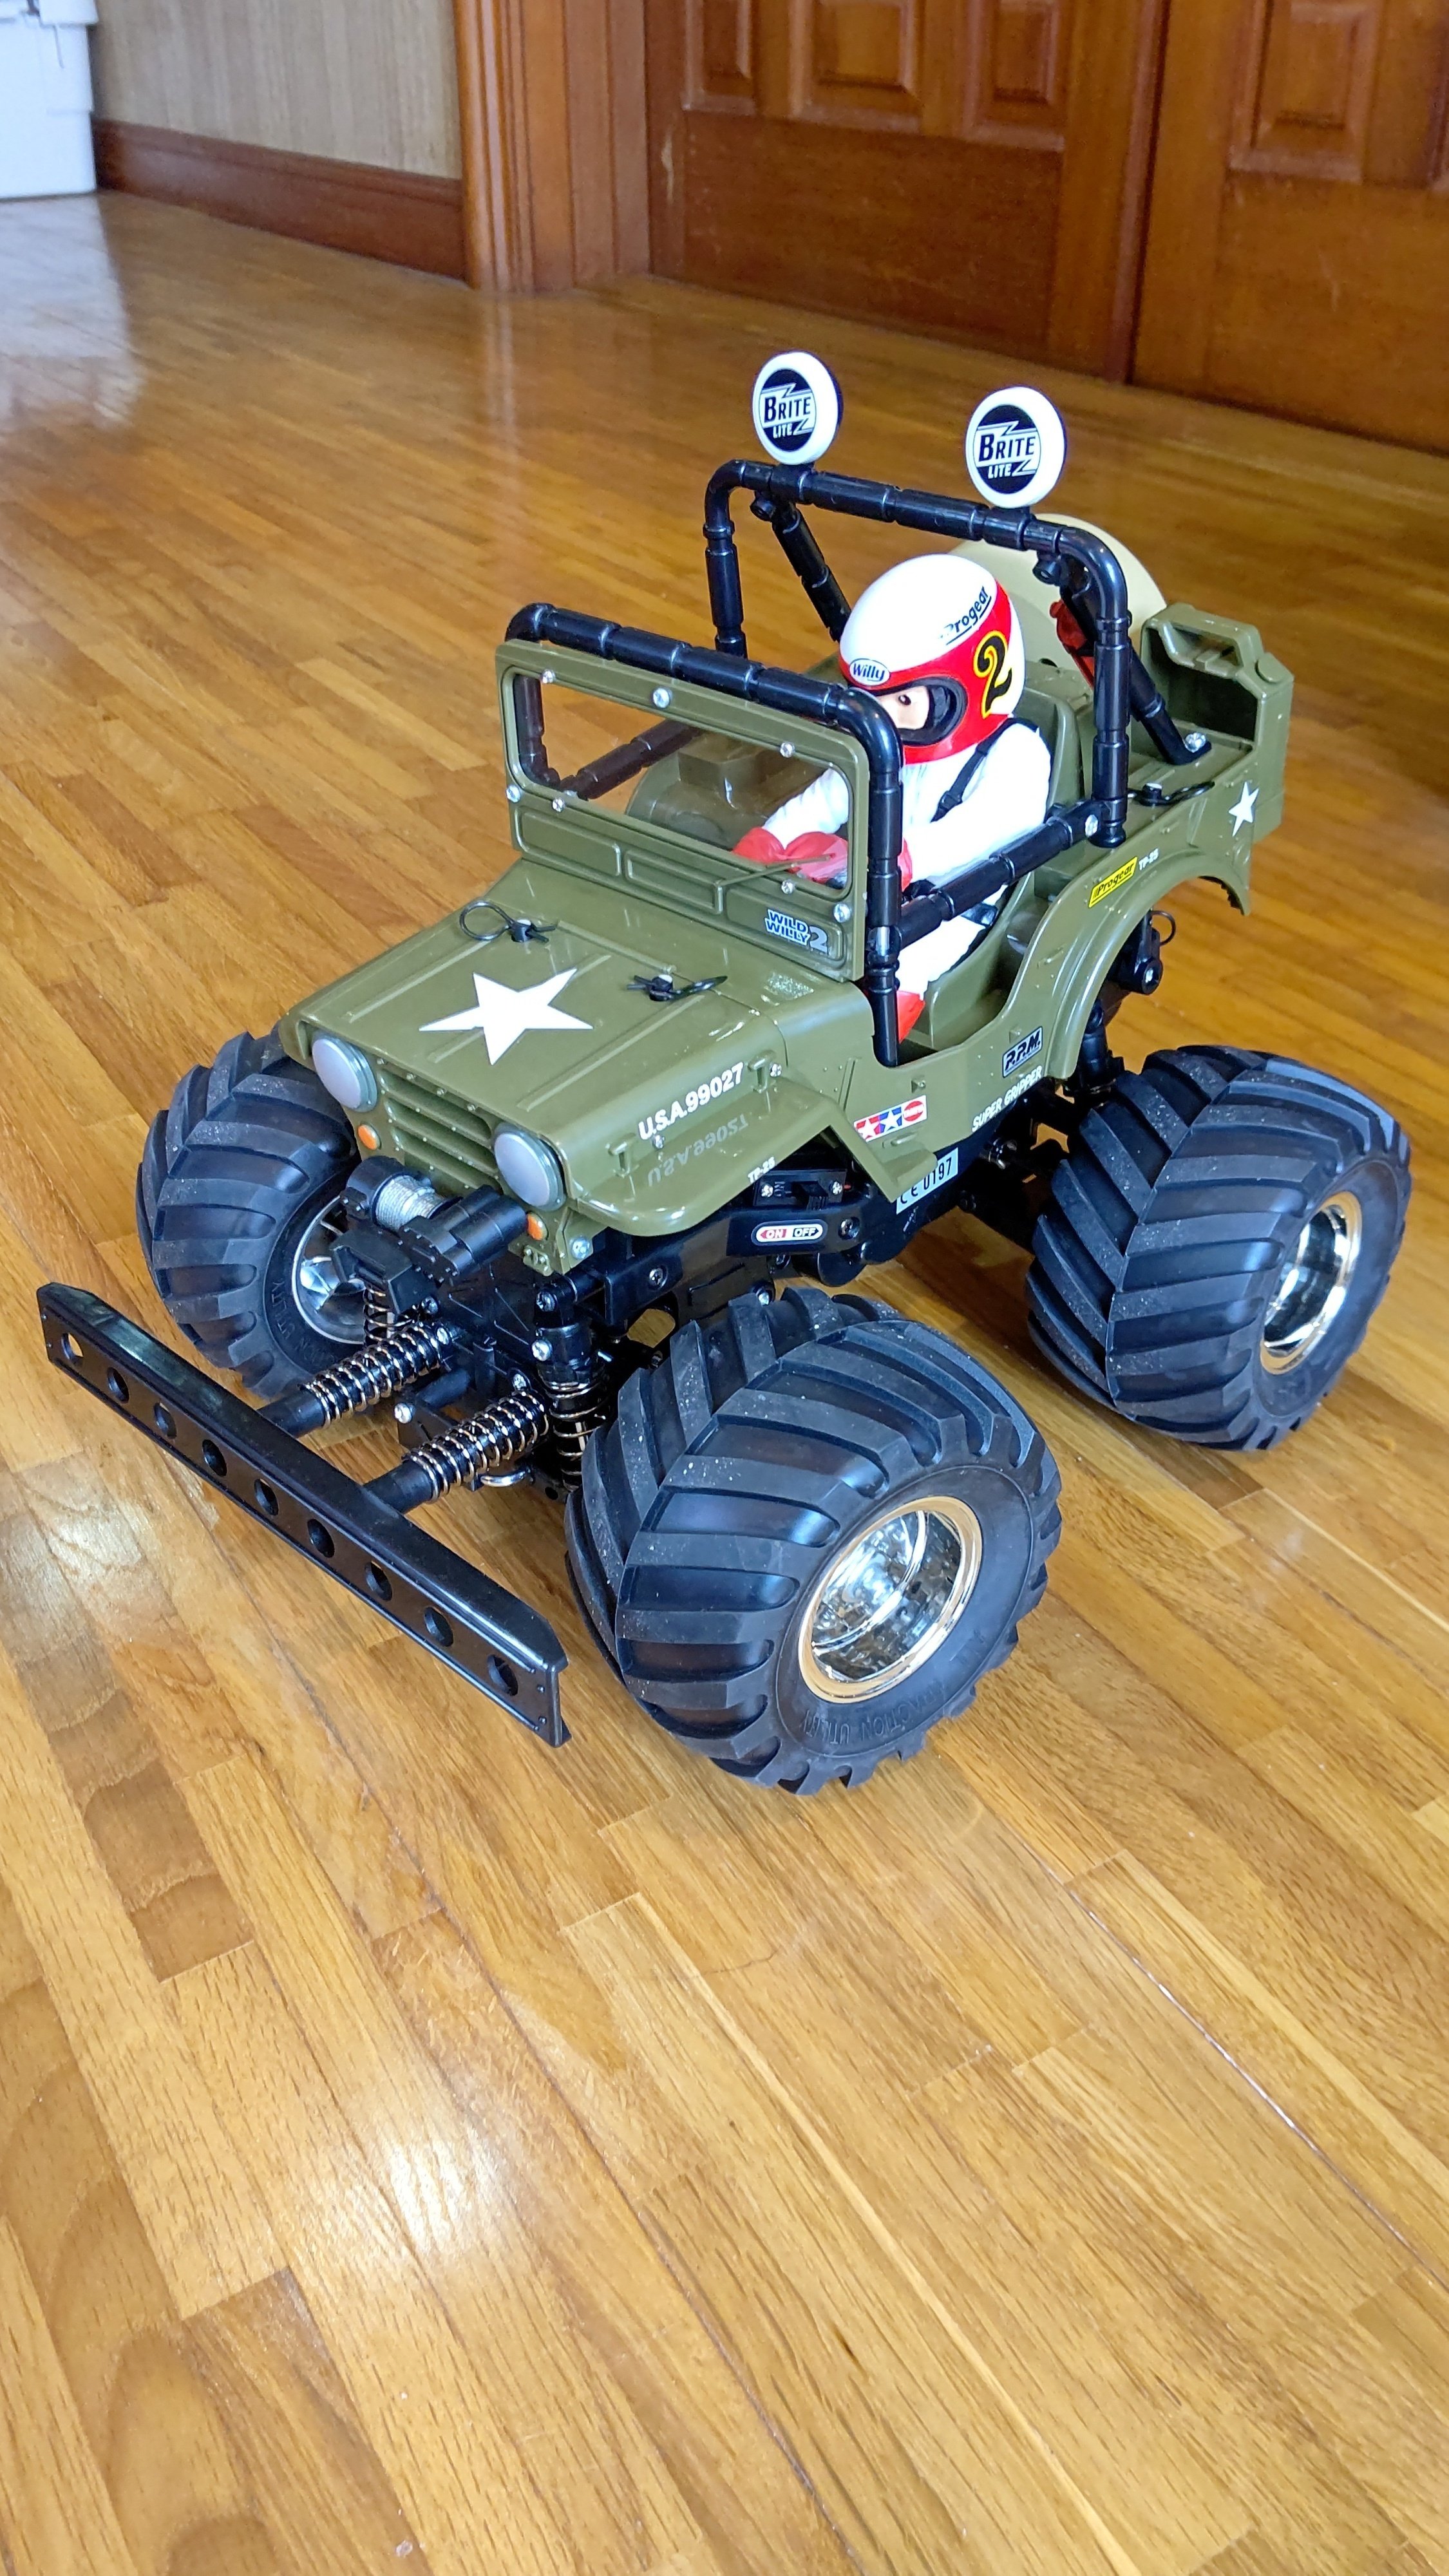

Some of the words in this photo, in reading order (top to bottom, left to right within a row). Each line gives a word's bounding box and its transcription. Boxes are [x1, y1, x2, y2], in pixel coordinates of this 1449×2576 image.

[763, 394, 811, 423] BRITE
[773, 422, 793, 439] LITE
[978, 432, 1036, 462] BRITE
[987, 462, 1012, 480] LITE
[852, 663, 886, 682] Willy
[974, 630, 1012, 718] 2
[1097, 863, 1135, 896] Progear
[768, 910, 808, 933] WILD
[766, 919, 809, 943] WILLY
[810, 925, 828, 954] 2
[972, 1097, 1002, 1133] SUPER
[1004, 1065, 1043, 1105] GRIPPER
[766, 1229, 784, 1239] ON
[795, 1227, 816, 1237] OFF
